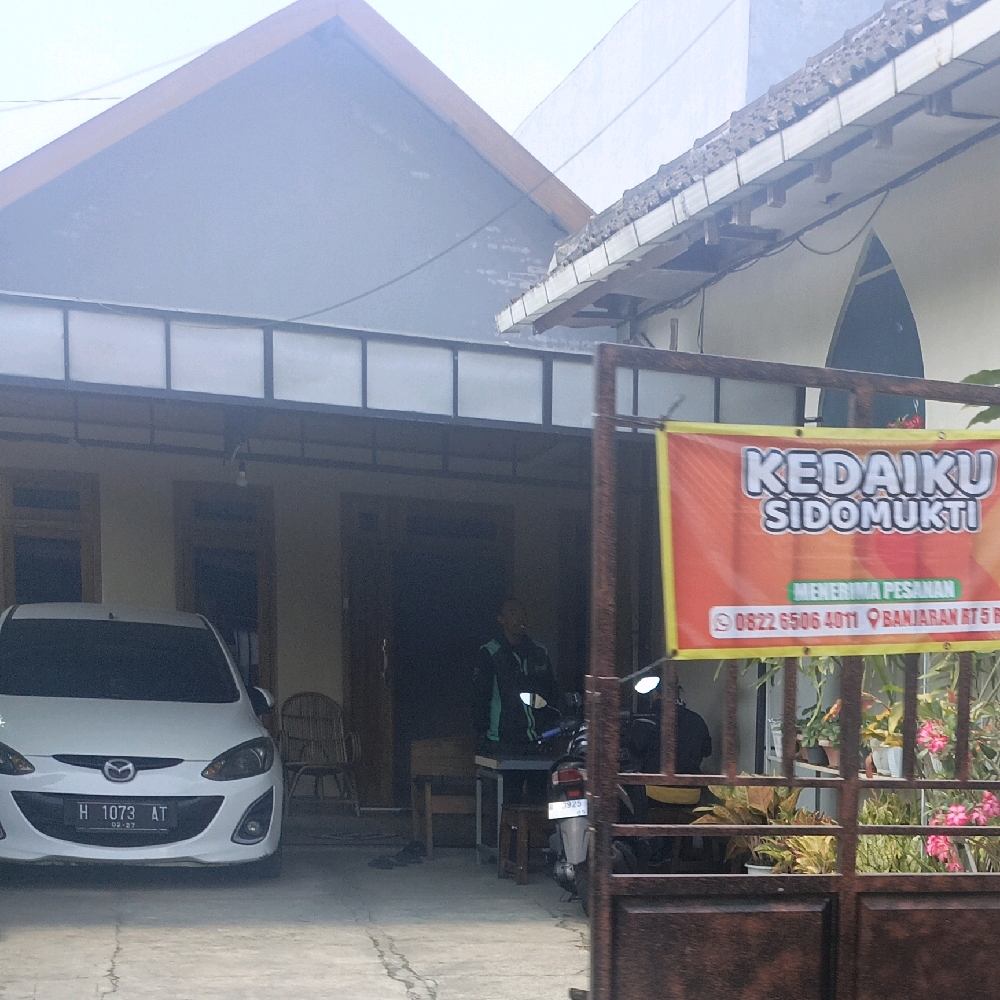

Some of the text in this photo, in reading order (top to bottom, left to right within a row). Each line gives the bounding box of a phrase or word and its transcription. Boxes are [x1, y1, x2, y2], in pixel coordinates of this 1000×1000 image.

[742, 446, 997, 499] KEDAIKU
[761, 498, 982, 534] SIDOMUKTI
[793, 580, 955, 602] MENERIMA PESANAN
[735, 611, 777, 631] 0822
[780, 611, 821, 630] 6506
[825, 610, 859, 629] 4011
[882, 608, 958, 627] BANJARAN
[961, 607, 977, 625] RT
[980, 607, 990, 625] 5
[79, 804, 168, 821] H 1073 AT
